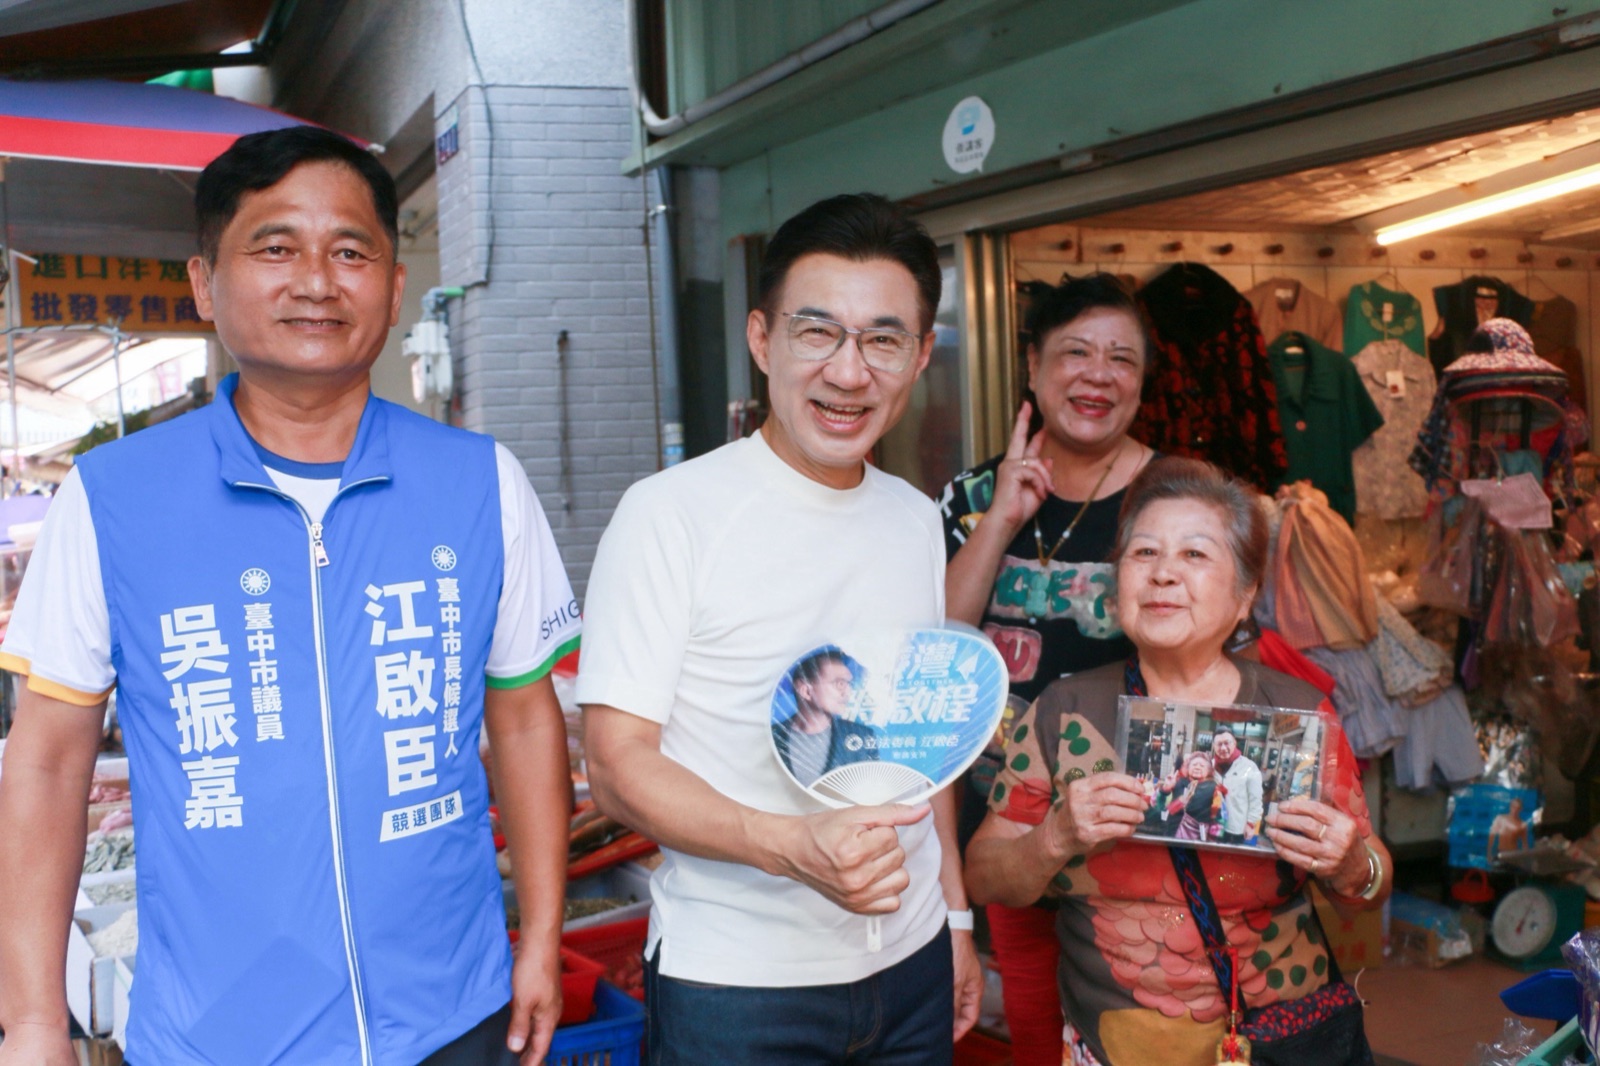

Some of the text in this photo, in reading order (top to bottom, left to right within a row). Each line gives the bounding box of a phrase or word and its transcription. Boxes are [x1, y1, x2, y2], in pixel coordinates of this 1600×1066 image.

[160, 604, 244, 830] 吳振嘉
[243, 602, 285, 742] 臺中市議員
[364, 580, 438, 797] 江啟臣
[436, 577, 462, 759] 臺中市長候選人
[391, 797, 458, 833] 競選團隊
